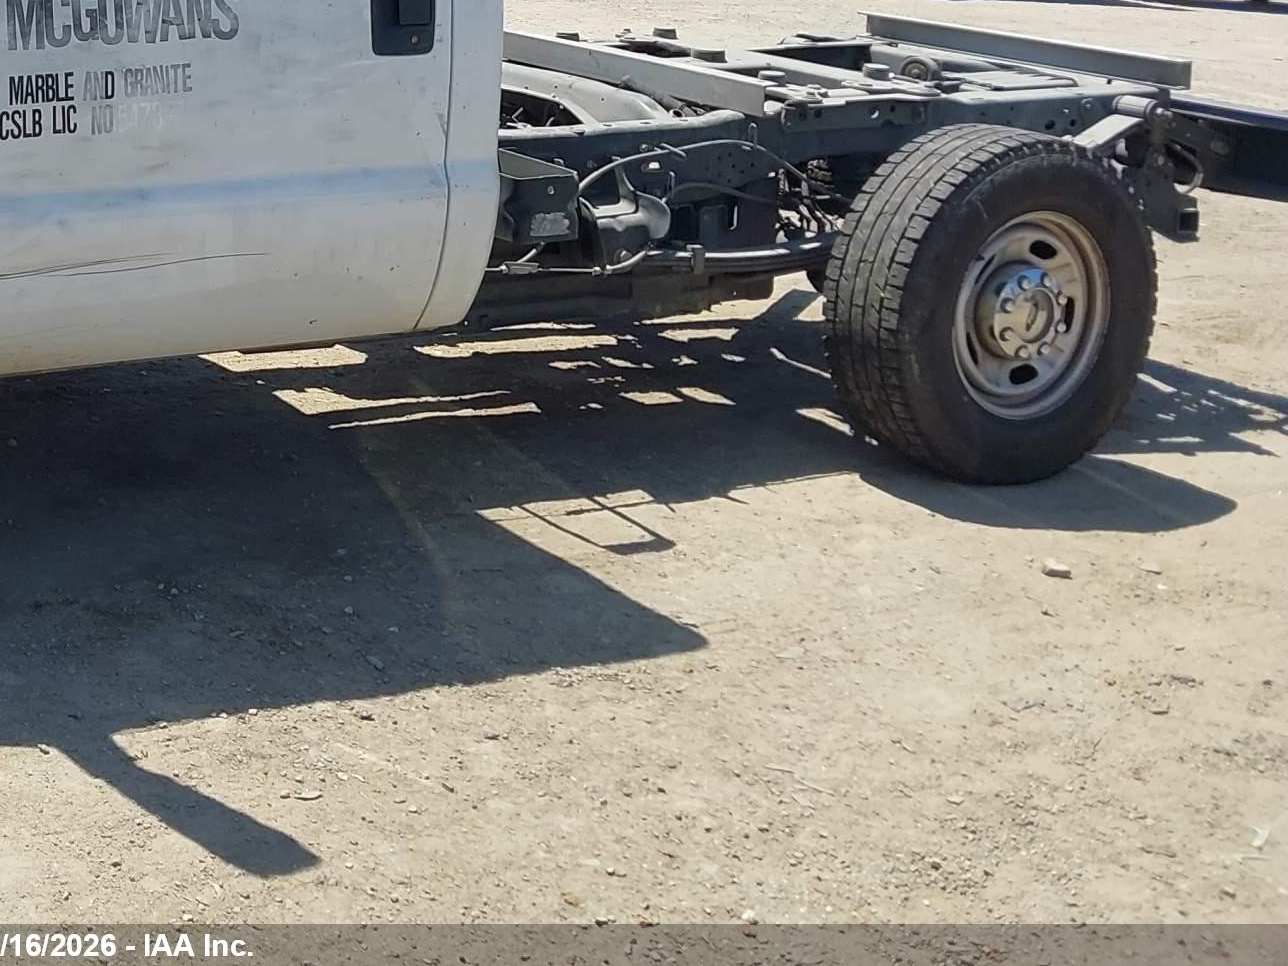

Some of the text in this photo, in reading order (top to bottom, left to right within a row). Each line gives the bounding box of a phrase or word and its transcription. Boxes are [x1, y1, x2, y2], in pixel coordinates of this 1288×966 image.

[9, 62, 193, 106] MARBLE AND GRANITE
[52, 104, 78, 135] LIC
[91, 104, 114, 135] NO
